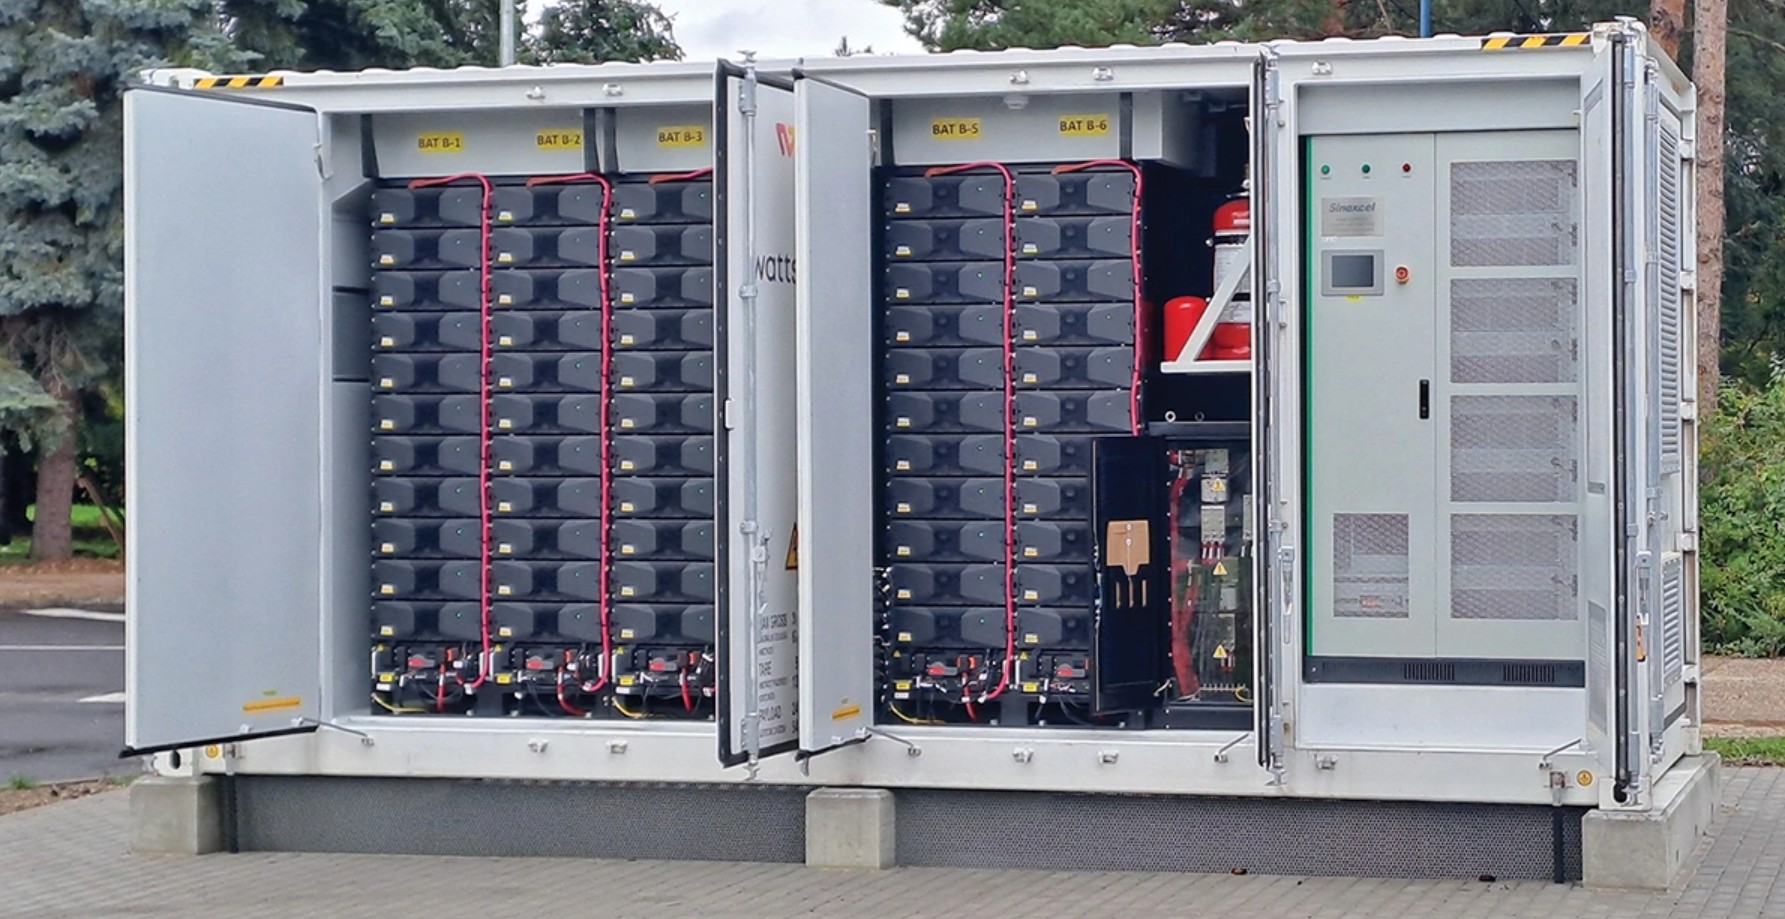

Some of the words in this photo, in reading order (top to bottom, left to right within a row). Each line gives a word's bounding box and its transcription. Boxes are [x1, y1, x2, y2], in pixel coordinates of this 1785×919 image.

[932, 123, 955, 135] BAT
[959, 123, 979, 135] B-5
[1060, 120, 1082, 132] BAT
[1087, 119, 1107, 131] B-6
[537, 135, 558, 146] BAT
[562, 134, 581, 145] B-2
[658, 131, 680, 143] BAT
[683, 130, 703, 142] B-3
[418, 137, 438, 149] BAT
[442, 137, 461, 148] B-1
